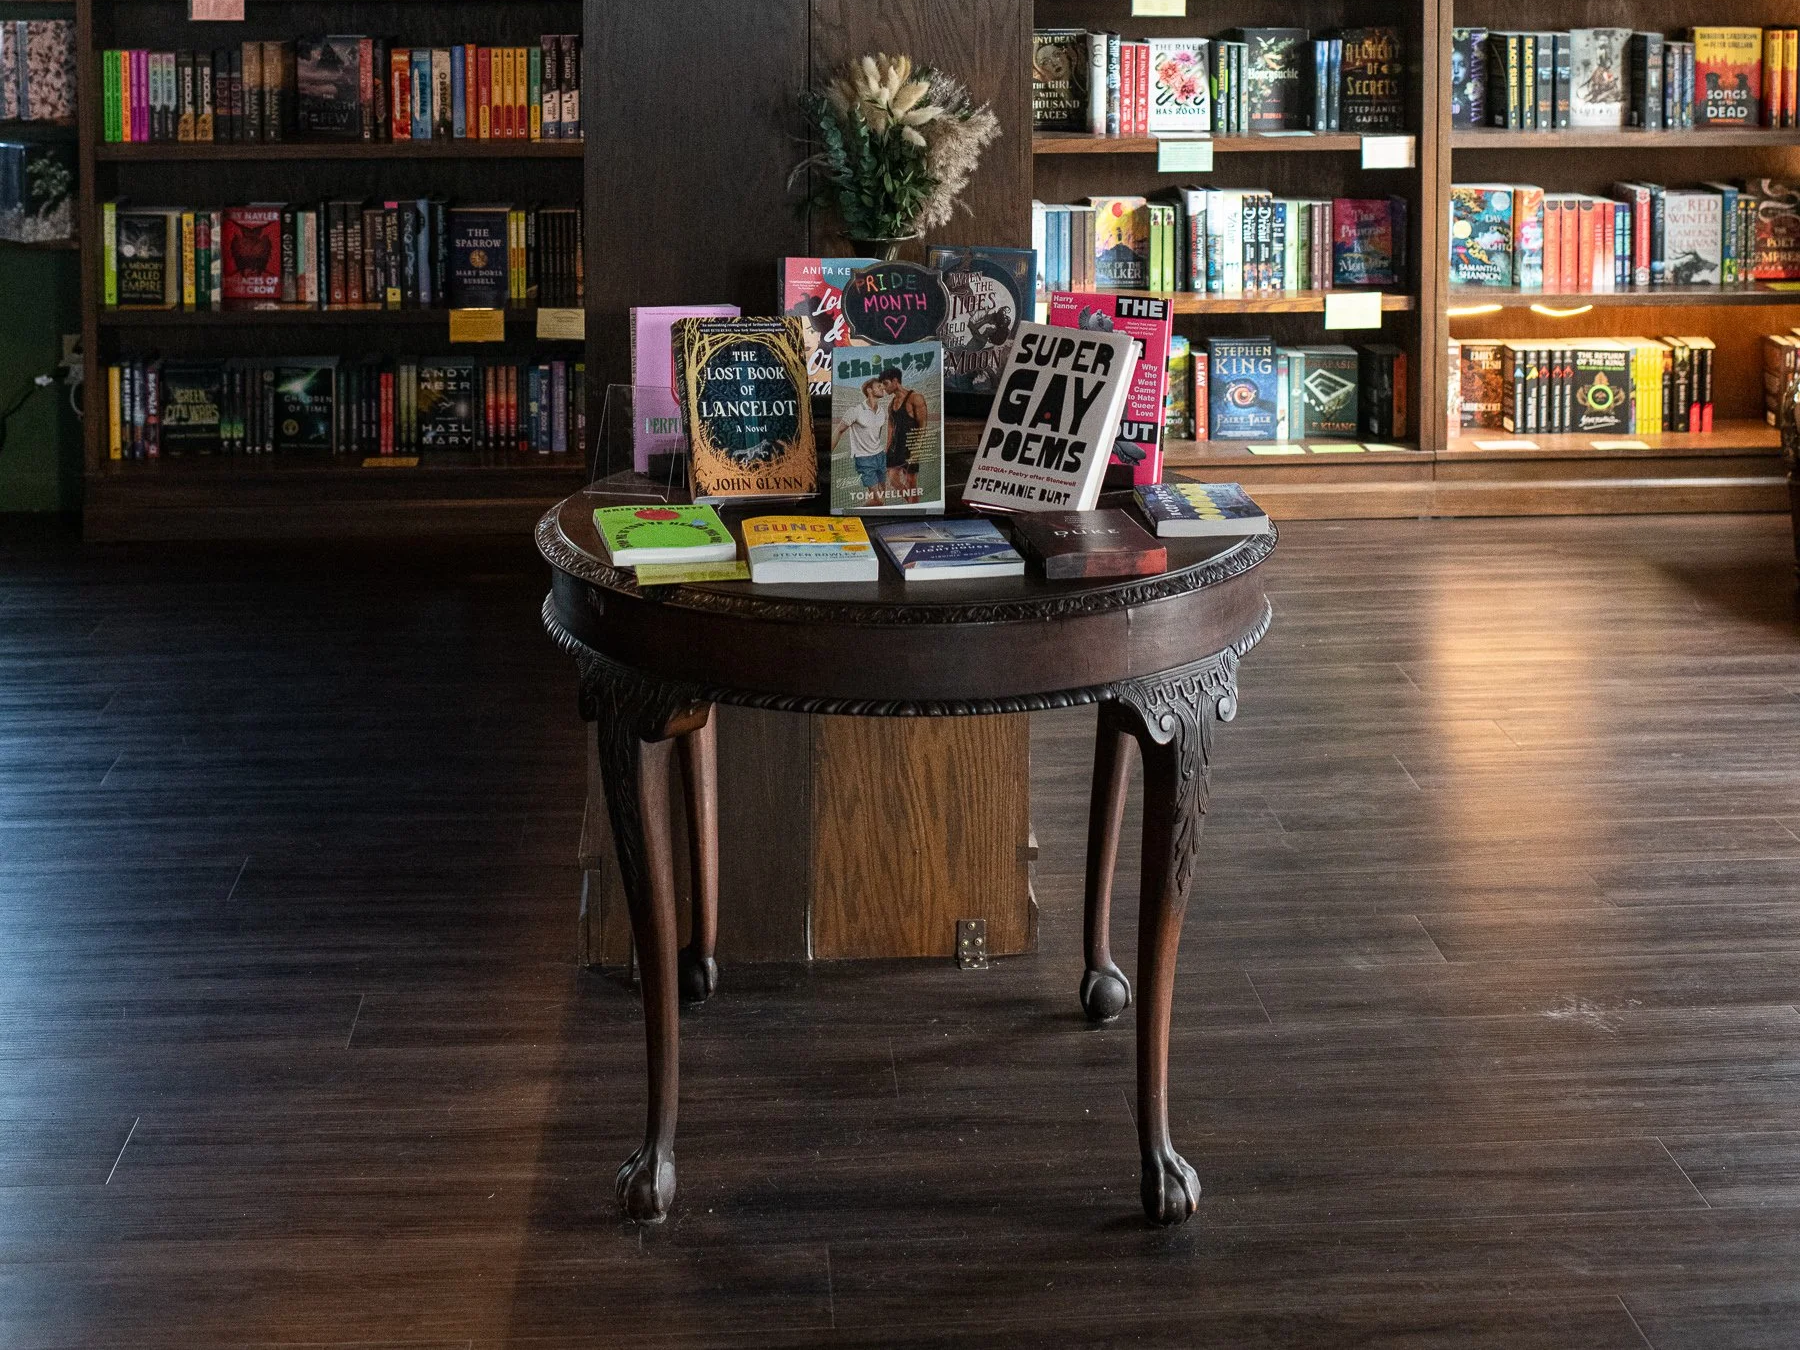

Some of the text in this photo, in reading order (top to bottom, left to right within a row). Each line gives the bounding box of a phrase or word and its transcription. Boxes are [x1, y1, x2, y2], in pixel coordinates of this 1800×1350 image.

[1109, 39, 1119, 58] SHIP
[1047, 80, 1073, 90] GIRL
[1155, 106, 1206, 115] HAS ROOTS
[1706, 106, 1748, 118] DEAD
[1687, 198, 1719, 212] RED
[1668, 213, 1719, 225] WINTER
[466, 228, 490, 237] THE
[455, 238, 502, 248] SPARROW
[802, 266, 834, 275] ANITA
[1458, 263, 1502, 274] SAMANTHA
[950, 271, 983, 289] WHEN
[1458, 271, 1501, 281] SHANNON
[853, 271, 918, 294] PRIDE
[974, 281, 994, 292] THE
[862, 292, 928, 314] MONTH
[1053, 295, 1075, 305] Harry
[1053, 302, 1078, 311] Tanner
[1118, 298, 1164, 318] THE
[823, 316, 845, 343] &
[732, 350, 757, 362] THE
[1014, 332, 1115, 377] SUPER
[1214, 346, 1272, 357] STEPHEN
[1470, 350, 1494, 362] EMILY
[1576, 351, 1626, 360] THE RETURN
[837, 350, 935, 380] thirty
[948, 349, 1003, 375] MOON
[1141, 363, 1158, 372] Why
[1215, 358, 1273, 375] KING
[1481, 360, 1502, 370] TESH
[1576, 358, 1587, 366] OF
[1605, 358, 1626, 367] KING
[420, 368, 470, 378] ANDY
[706, 366, 785, 381] LOST BOOK
[1144, 371, 1158, 379] the
[420, 381, 471, 391] WEIR
[1137, 378, 1157, 387] West
[740, 384, 755, 396] OF
[1134, 385, 1156, 394] Came
[997, 368, 1107, 437] GAY
[1128, 393, 1155, 402] to Hate
[701, 399, 797, 418] LANCELOT
[1131, 401, 1155, 410] Queer
[1135, 409, 1154, 417] Love
[421, 423, 472, 433] HAIL
[736, 424, 768, 433] A Novel
[421, 436, 472, 446] MARY
[982, 427, 1088, 474] POEMS
[712, 474, 803, 492] JOHN GLYNN
[1008, 469, 1029, 479] Poetry
[1029, 473, 1045, 482] after
[1045, 476, 1078, 488] Stonewall
[849, 487, 924, 501] TOM VELLNER
[972, 477, 1071, 506] STEPHANIE BURT
[753, 522, 858, 533] GUNCLE
